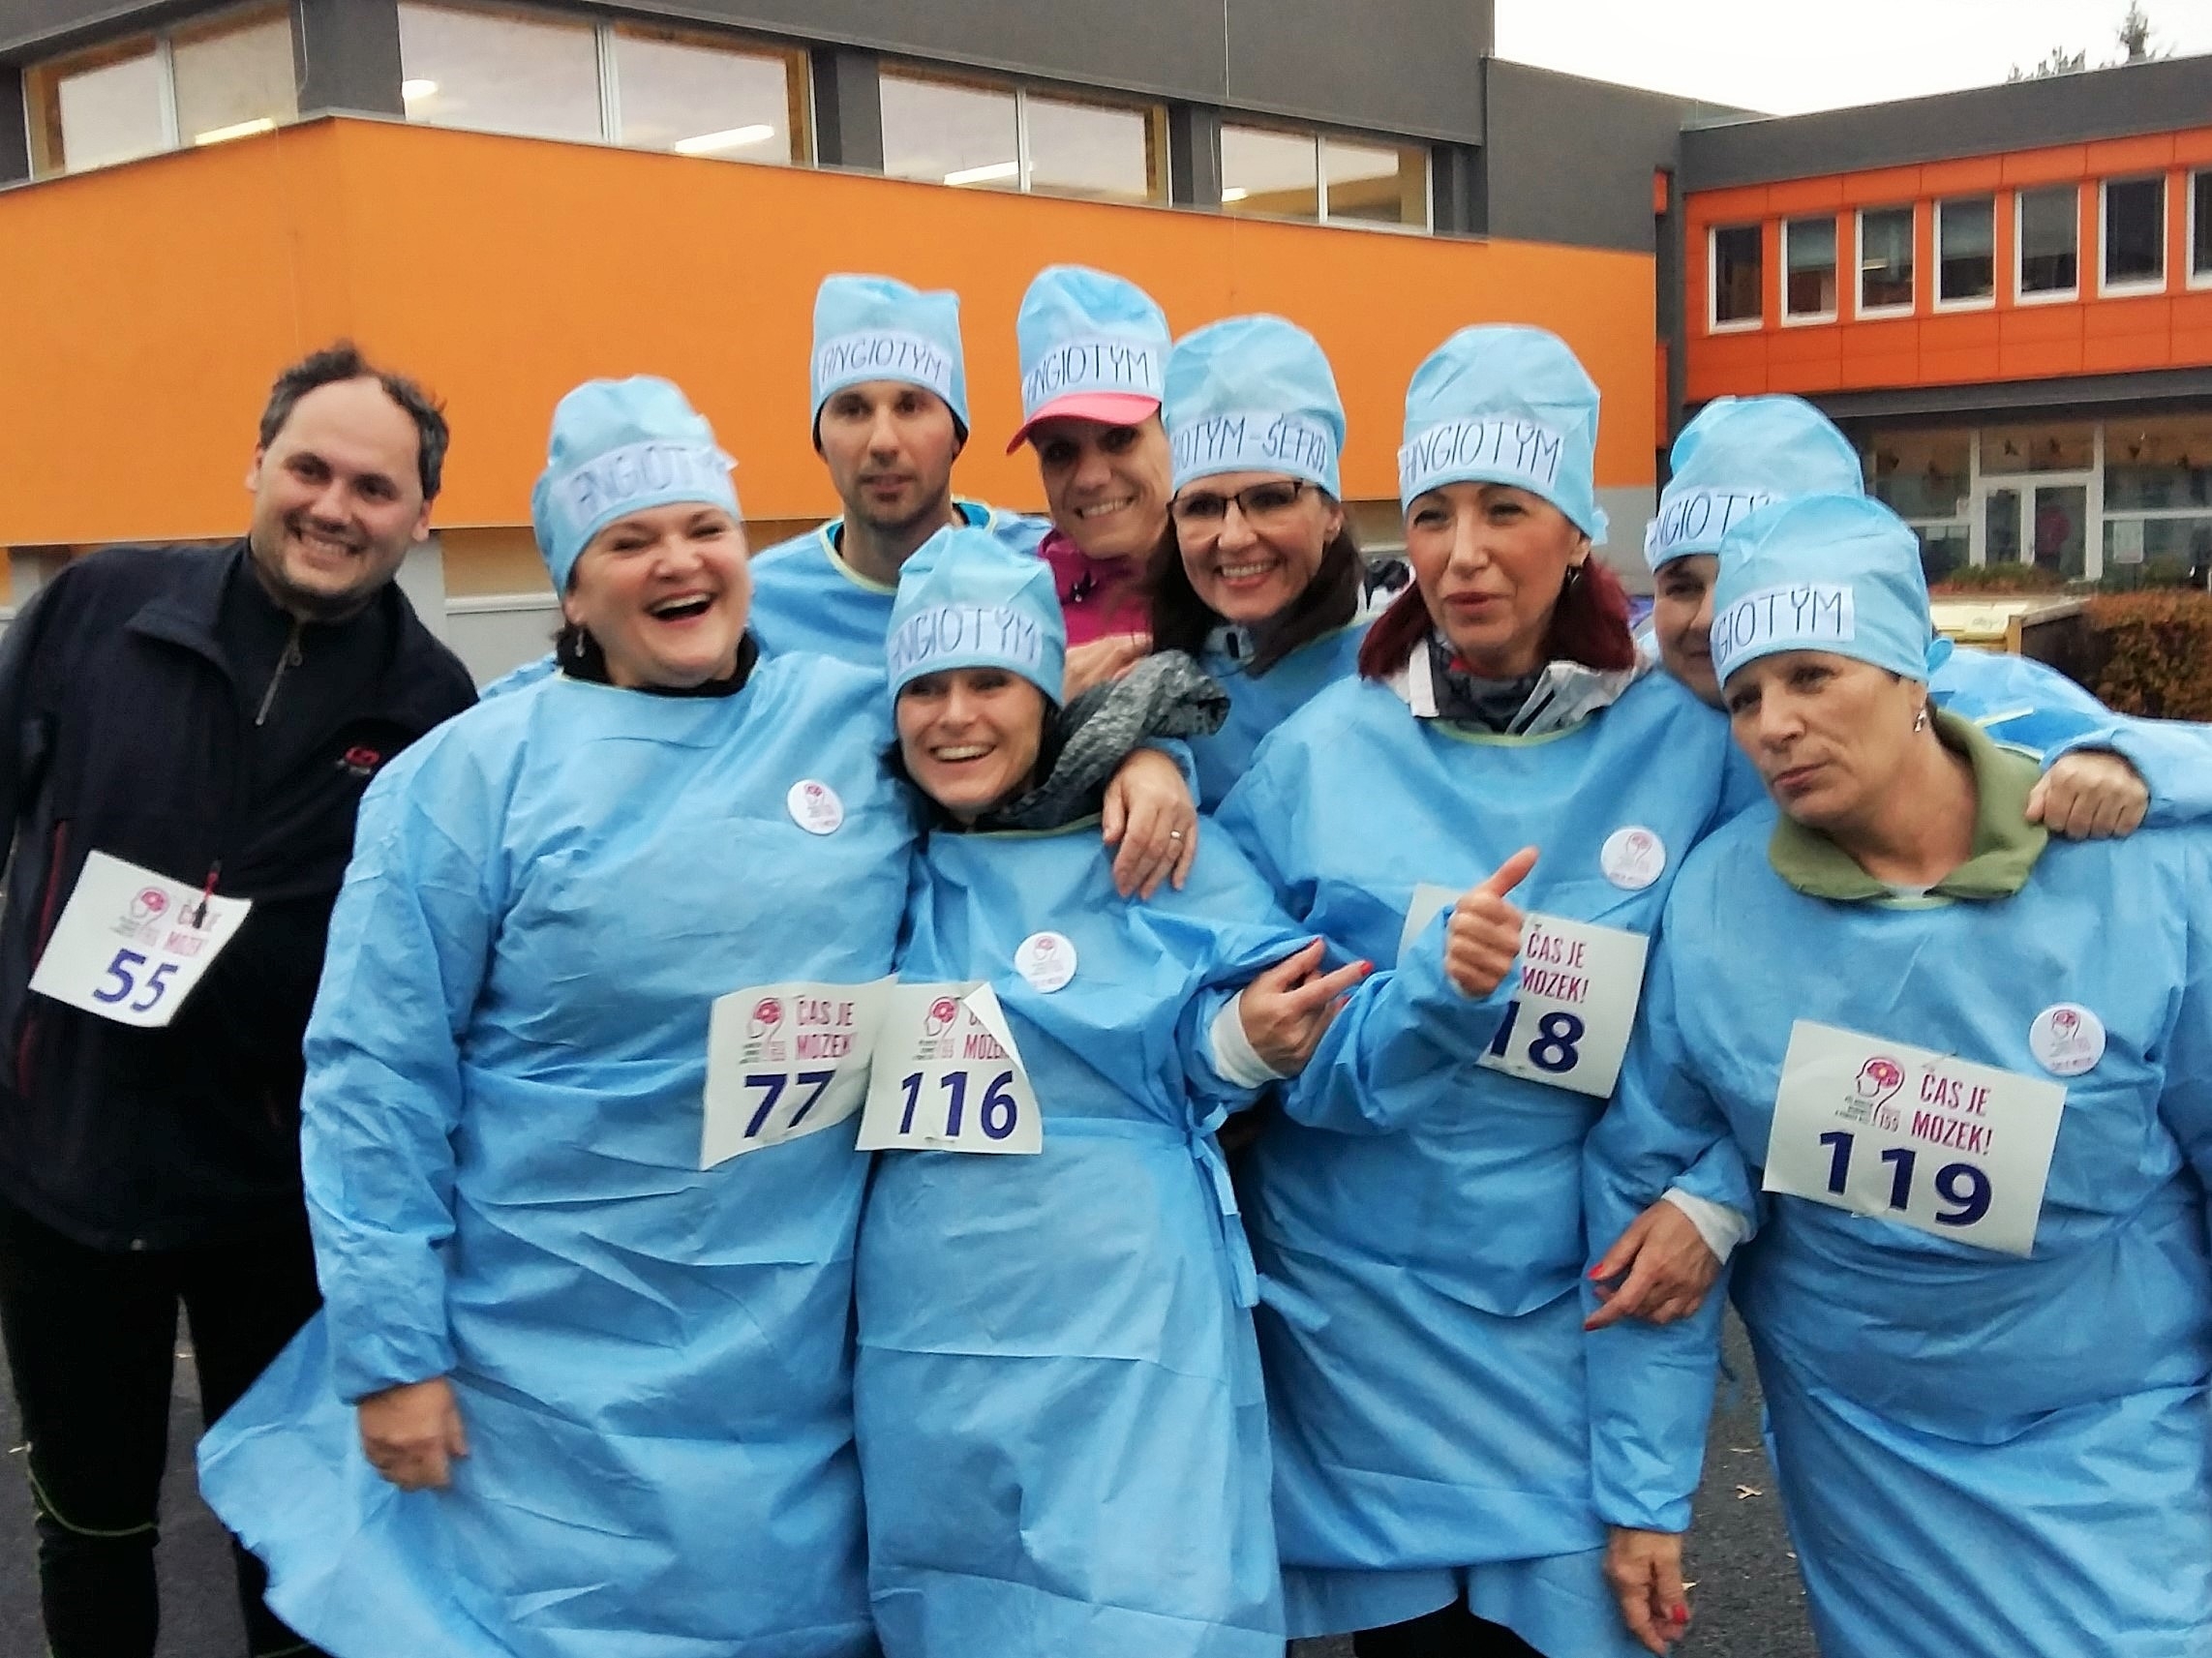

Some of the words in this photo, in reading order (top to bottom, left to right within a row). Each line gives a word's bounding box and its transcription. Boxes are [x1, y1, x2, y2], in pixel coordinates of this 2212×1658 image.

[1527, 923, 1563, 965] ČAS
[1566, 941, 1586, 969] JE
[92, 948, 179, 1012] 55
[742, 1070, 836, 1139] 77
[899, 1070, 1018, 1140] 116
[1965, 1086, 1990, 1116] JE
[1820, 1130, 1993, 1226] 119
